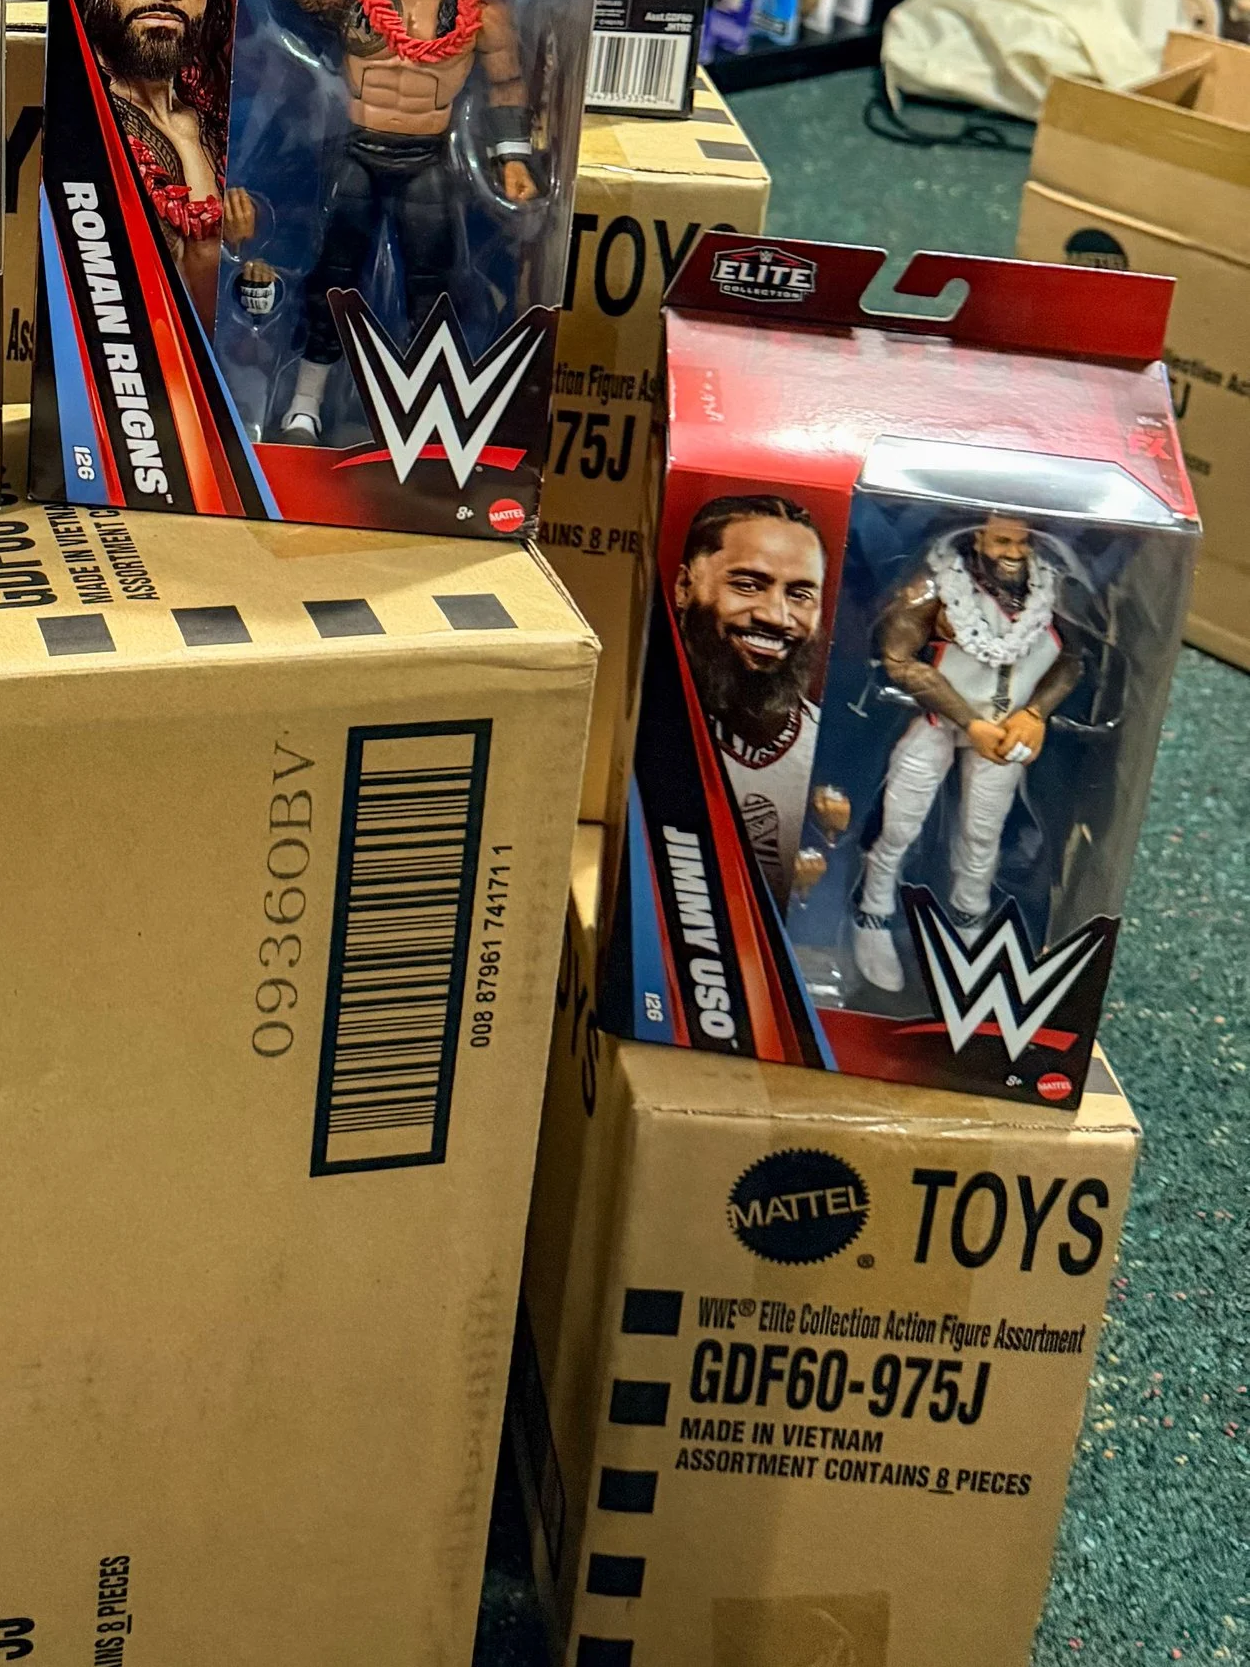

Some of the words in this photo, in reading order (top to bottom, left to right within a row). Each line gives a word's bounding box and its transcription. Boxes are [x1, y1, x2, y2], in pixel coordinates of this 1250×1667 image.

[716, 263, 813, 290] ELITE
[722, 284, 802, 299] COLLECTION
[61, 181, 131, 336] ROMAN
[104, 342, 169, 496] REIGNS
[587, 365, 636, 407] Figure
[71, 444, 95, 482] 126
[455, 506, 474, 522] 8+
[489, 507, 525, 521] MATTEL
[61, 548, 97, 563] IN
[93, 521, 161, 602] ASSORTMENT
[79, 564, 114, 605] MADE
[484, 866, 511, 933] 74171
[662, 825, 719, 955] JIMMY
[476, 939, 502, 1006] 87961
[644, 991, 664, 1023] 126
[689, 957, 737, 1039] USO
[470, 1011, 491, 1048] 008
[1037, 1080, 1072, 1093] MATTEL
[728, 1184, 870, 1229] MATTEL
[910, 1167, 1110, 1277] TOYS
[758, 1300, 797, 1334] Elite
[798, 1304, 879, 1340] Collection
[884, 1310, 937, 1345] Action
[940, 1313, 991, 1353] Figure
[993, 1320, 1086, 1354] Assortment
[689, 1337, 991, 1426] GDF60-975J
[679, 1416, 747, 1444] MADE
[751, 1422, 775, 1445] IN
[782, 1424, 885, 1454] VIETNAM
[674, 1448, 820, 1482] ASSORTMENT
[823, 1458, 930, 1489] CONTAINS
[935, 1469, 951, 1494] 8
[955, 1469, 1033, 1497] PIECES
[97, 1554, 130, 1620] PIECES
